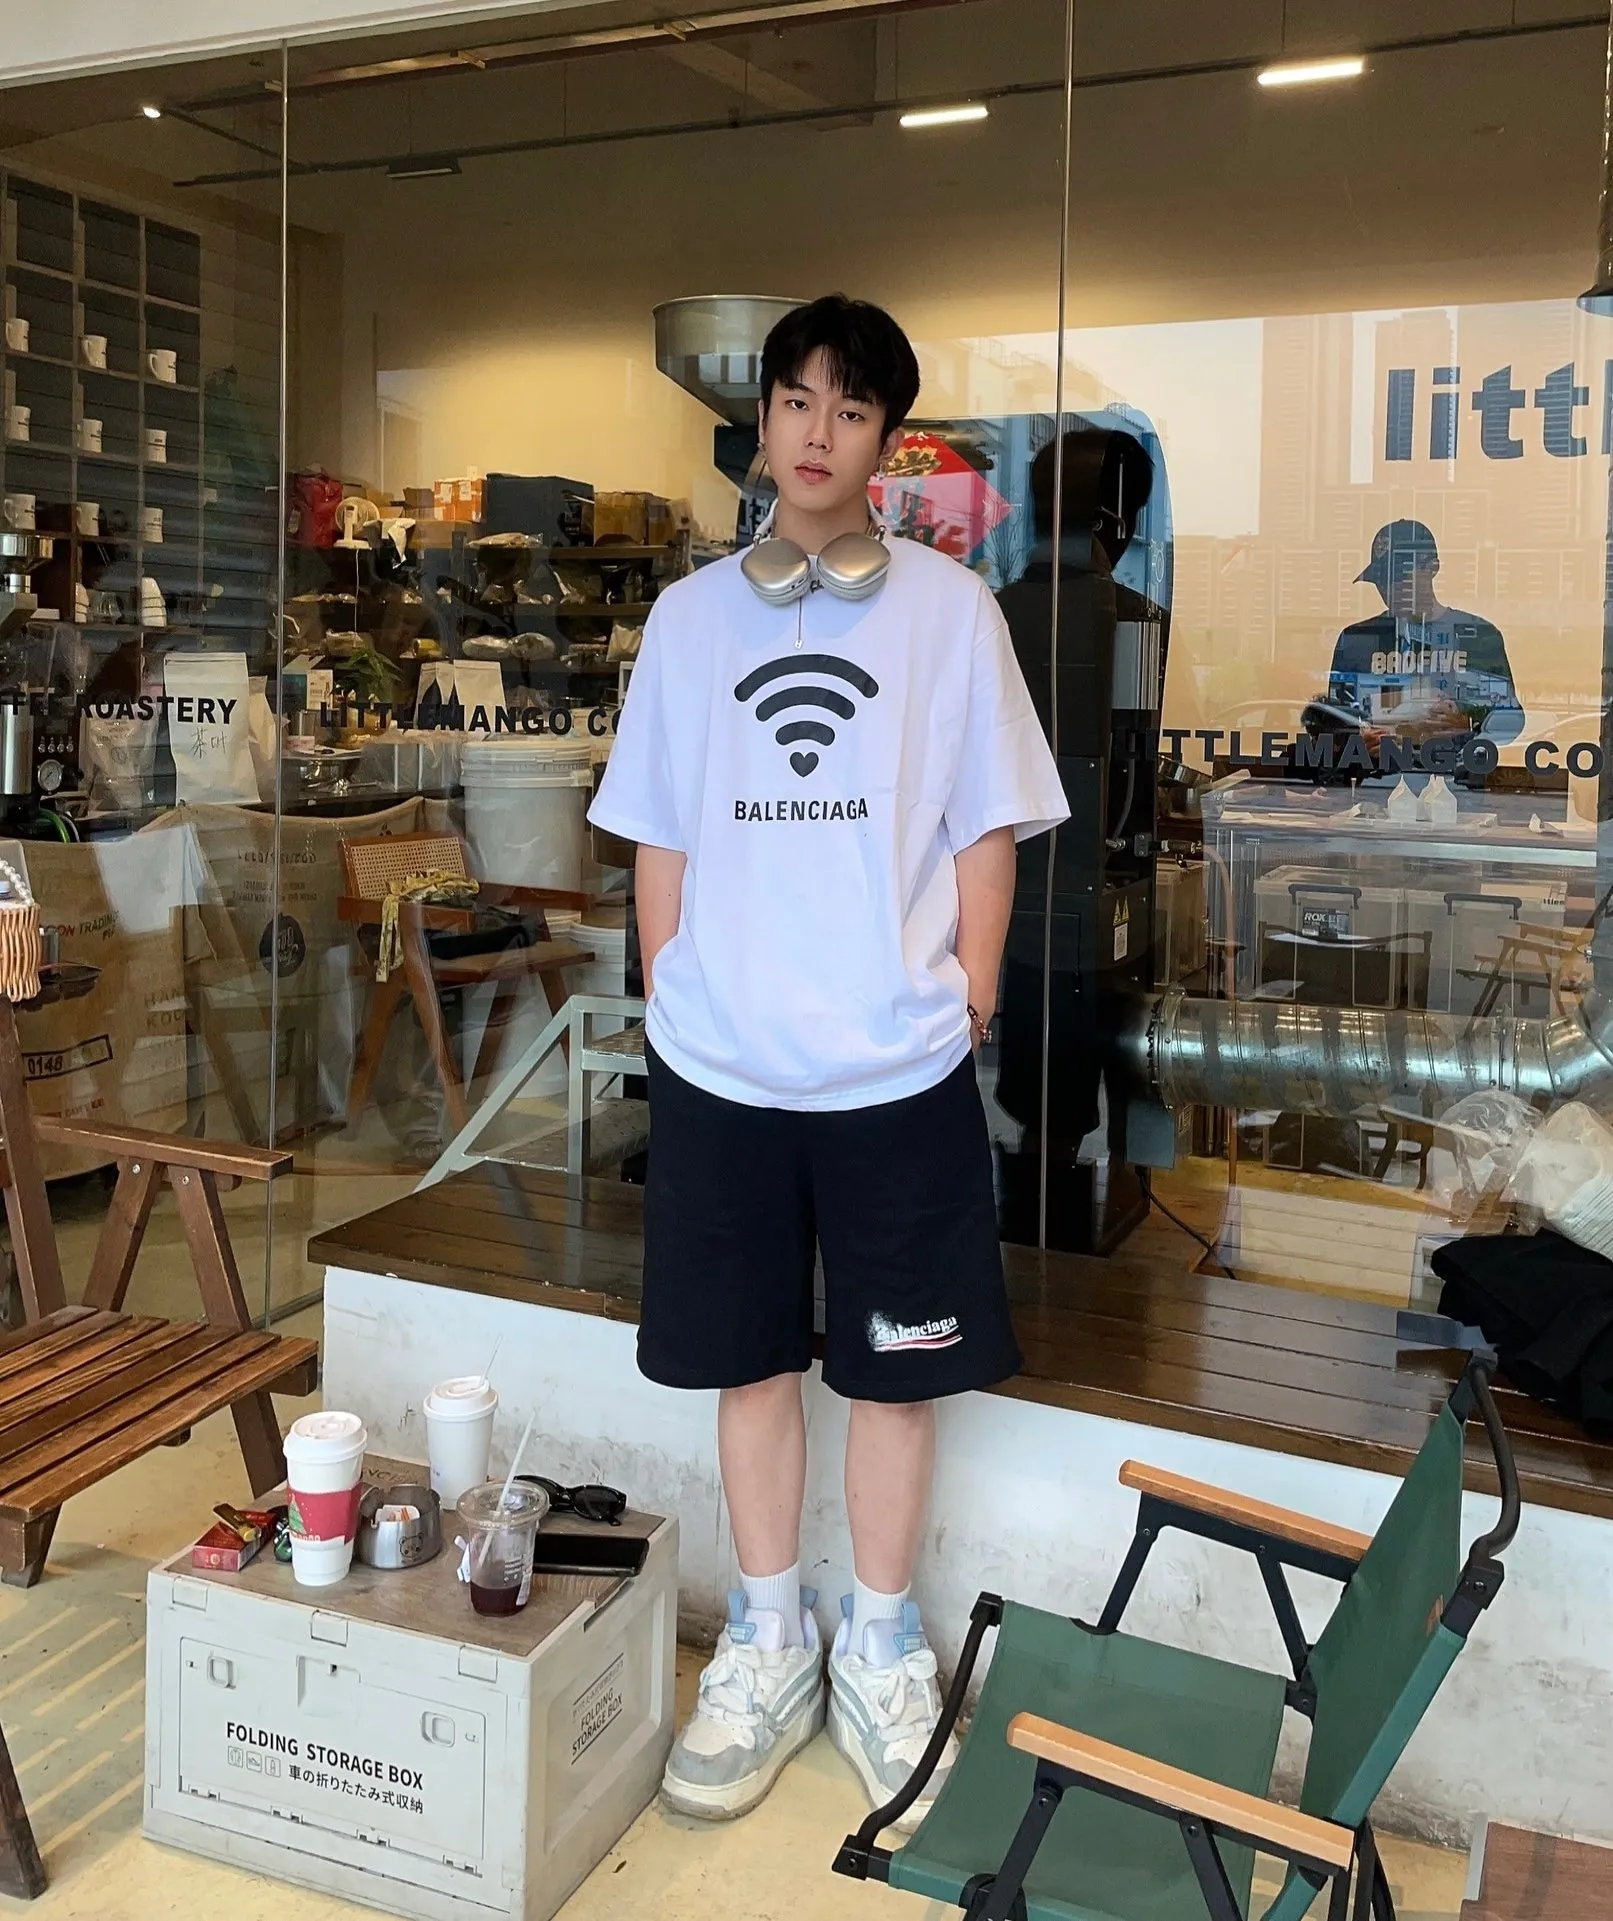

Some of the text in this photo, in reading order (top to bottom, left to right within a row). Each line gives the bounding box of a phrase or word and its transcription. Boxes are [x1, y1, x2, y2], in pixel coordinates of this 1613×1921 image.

[734, 798, 869, 822] BALENCIAGA
[572, 1710, 606, 1756] STORAGE
[608, 1692, 623, 1717] BOX
[581, 1687, 614, 1731] FOLDING
[226, 1721, 424, 1791] FOLDING STORAGE BOX
[288, 1764, 424, 1815] 車の折りたたみ式収納
